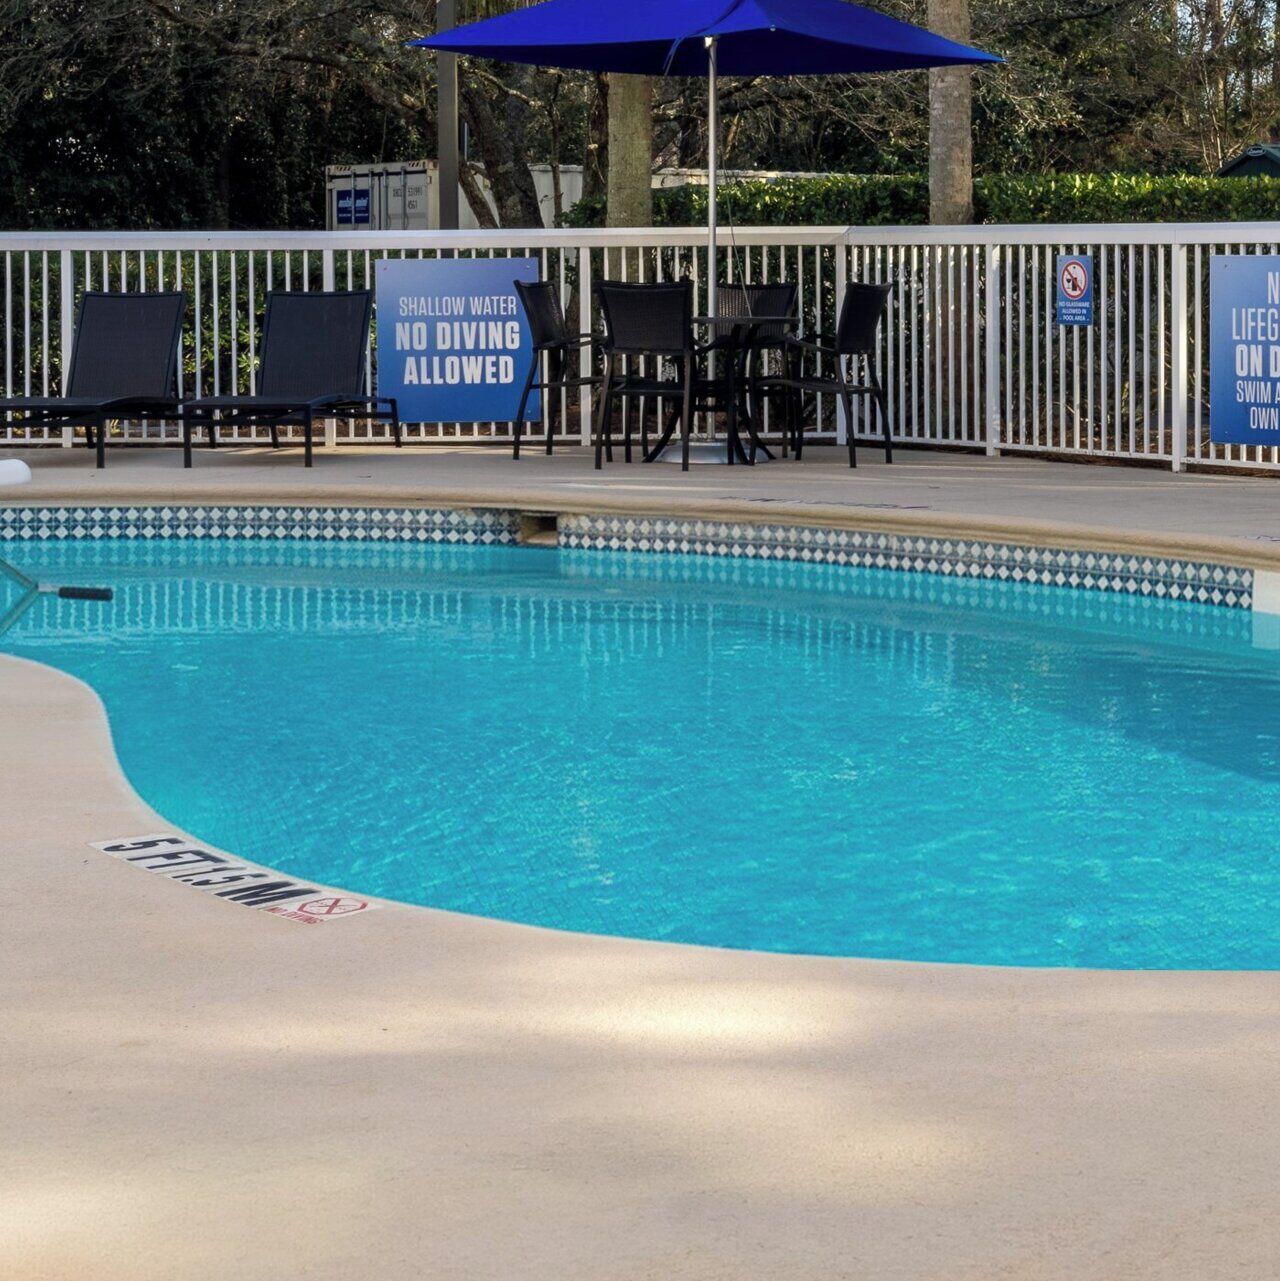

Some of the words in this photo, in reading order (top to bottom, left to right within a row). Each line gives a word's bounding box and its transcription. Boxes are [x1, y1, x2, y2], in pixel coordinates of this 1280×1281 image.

[400, 296, 465, 316] SHALLOW
[470, 296, 516, 315] WATER
[396, 322, 427, 350] NO
[437, 321, 519, 350] DIVING
[404, 356, 513, 384] ALLOWED
[1236, 344, 1262, 377] ON
[1237, 381, 1271, 403] SWIM
[1250, 407, 1278, 430] OWN
[102, 838, 185, 852] 5
[126, 849, 229, 870] FT
[171, 866, 269, 886] 1.5
[214, 881, 322, 906] M
